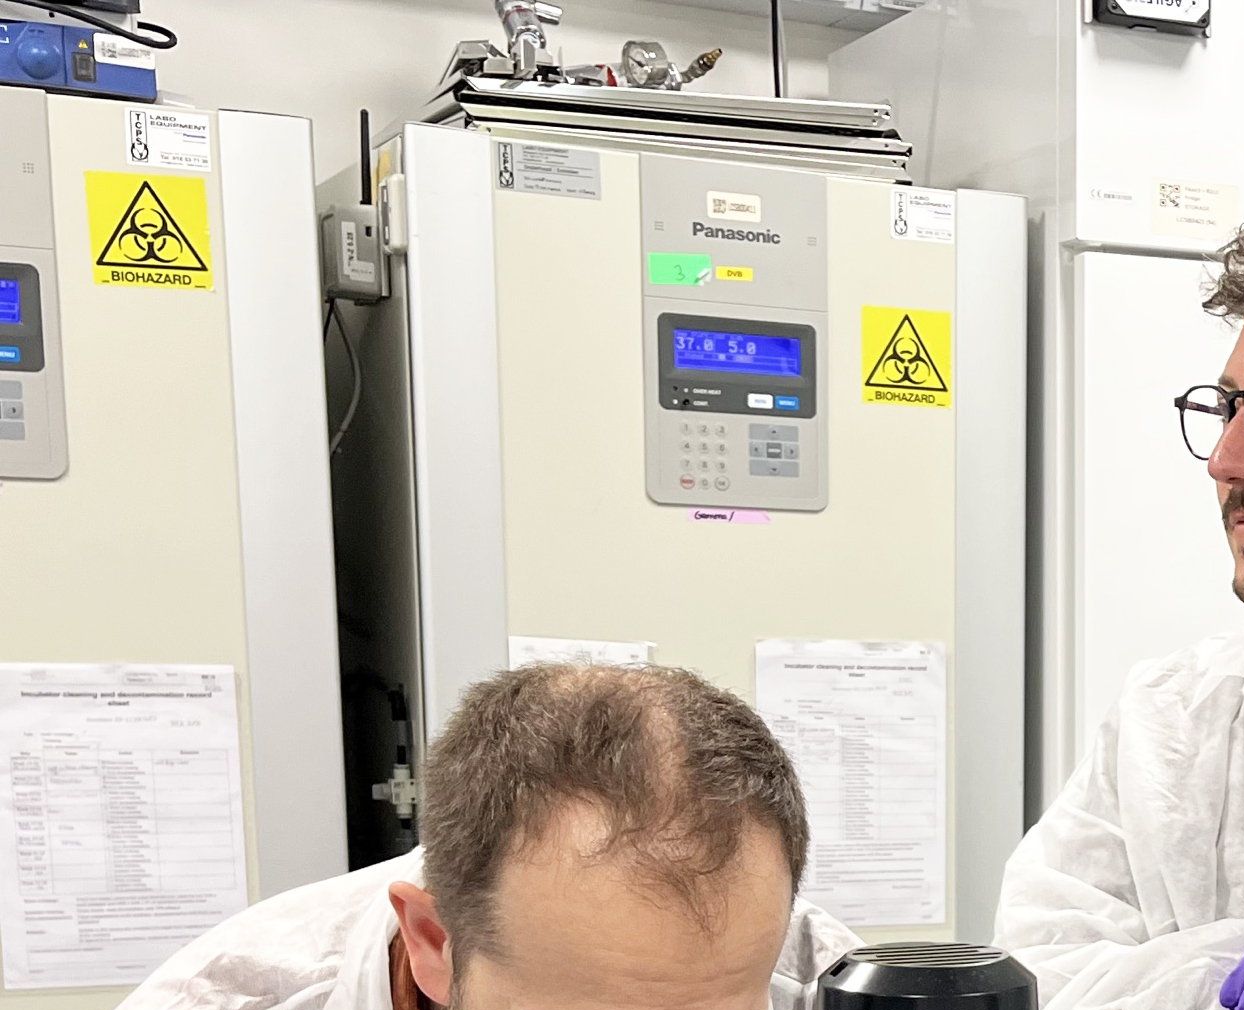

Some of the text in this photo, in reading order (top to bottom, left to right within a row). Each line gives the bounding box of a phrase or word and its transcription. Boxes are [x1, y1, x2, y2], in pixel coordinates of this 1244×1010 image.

[150, 121, 206, 131] EQUIPMENT
[692, 221, 782, 245] Panasonic
[111, 270, 192, 286] BIOHAZARD
[727, 340, 757, 355] 5.0
[875, 390, 936, 404] BIOHAZARD
